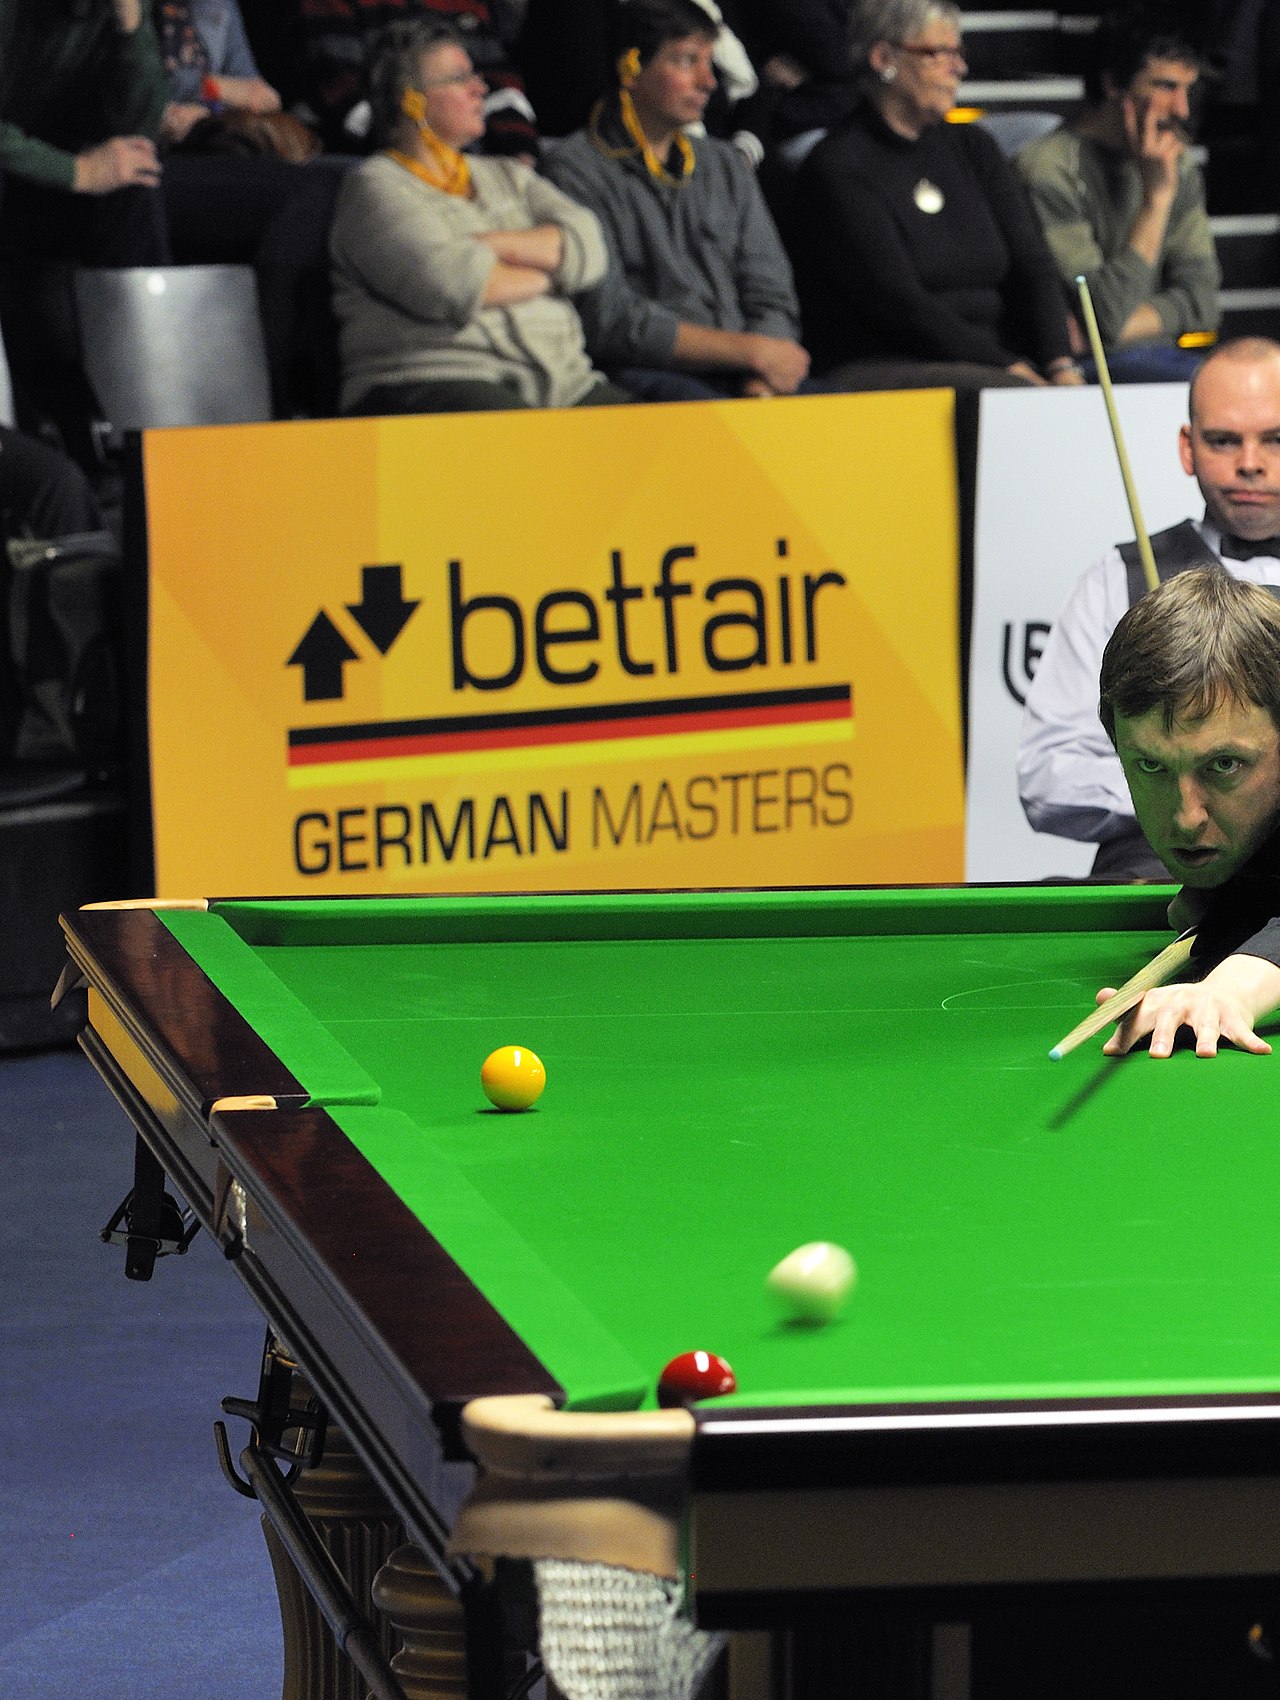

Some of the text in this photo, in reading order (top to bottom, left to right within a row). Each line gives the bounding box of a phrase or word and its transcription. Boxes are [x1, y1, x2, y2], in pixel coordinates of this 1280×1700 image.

[448, 538, 848, 692] betfair
[292, 763, 854, 877] GERMAN MASTERS
